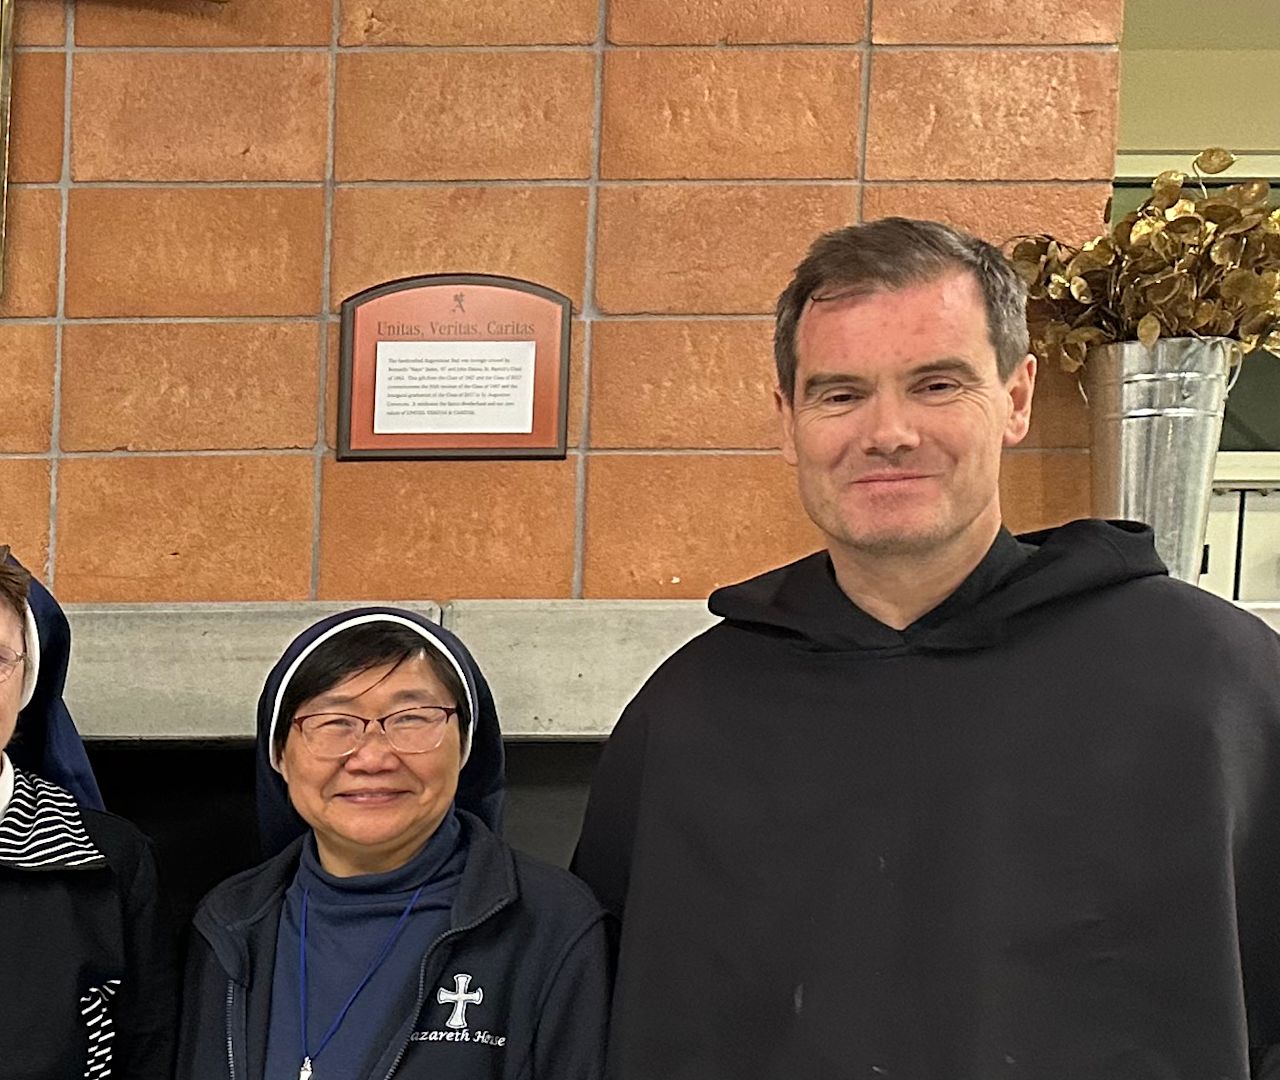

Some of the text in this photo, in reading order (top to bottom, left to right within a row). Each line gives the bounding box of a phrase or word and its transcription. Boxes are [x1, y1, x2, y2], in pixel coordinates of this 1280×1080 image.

[377, 320, 535, 337] Unitas, Veritas, Caritas
[410, 1029, 470, 1042] azareth
